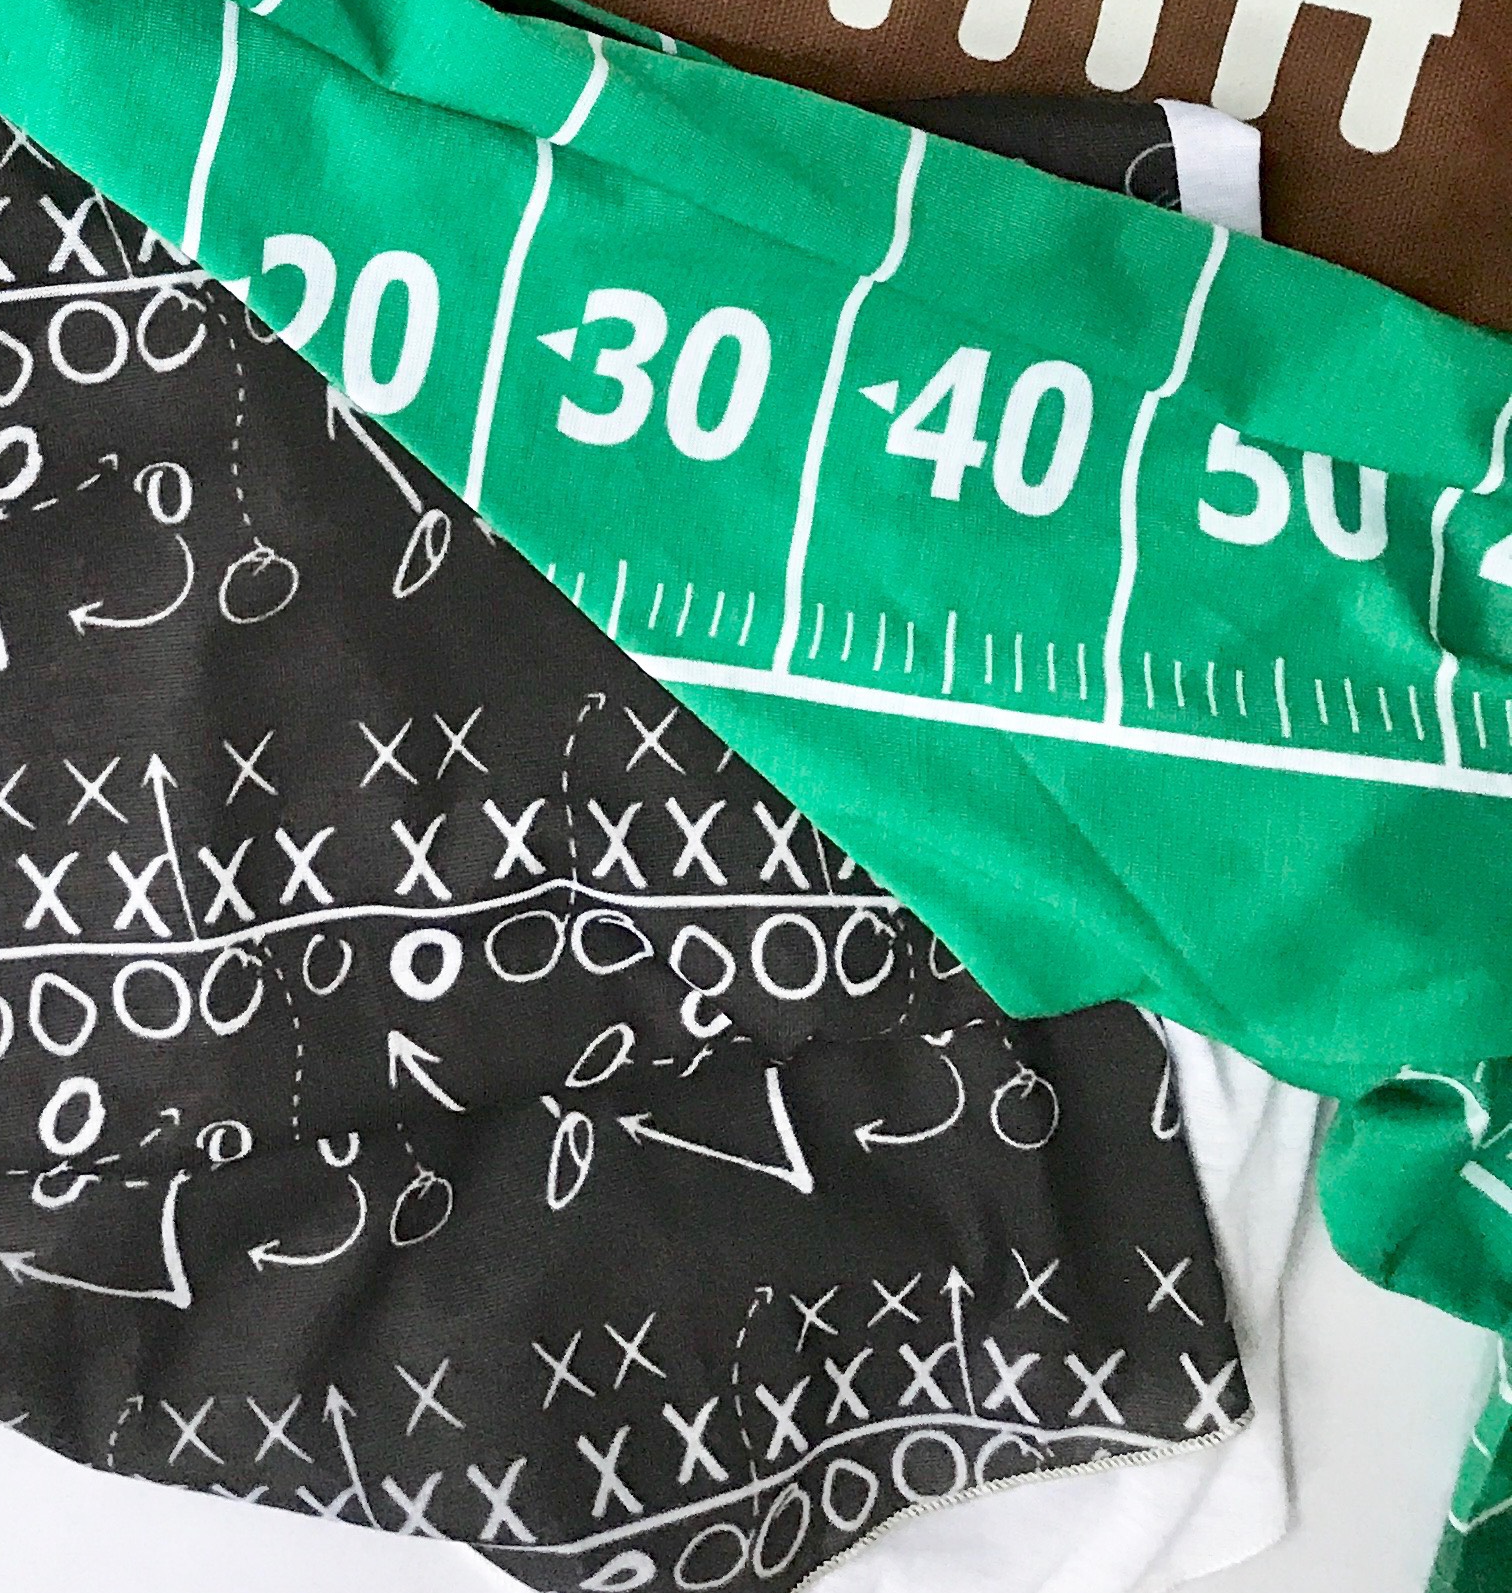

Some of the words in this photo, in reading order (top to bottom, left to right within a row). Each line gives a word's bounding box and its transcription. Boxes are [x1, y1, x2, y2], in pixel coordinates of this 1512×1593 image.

[262, 233, 440, 416] 20
[557, 287, 772, 461] 30
[885, 346, 1094, 517] 40
[1198, 422, 1388, 562] 50
